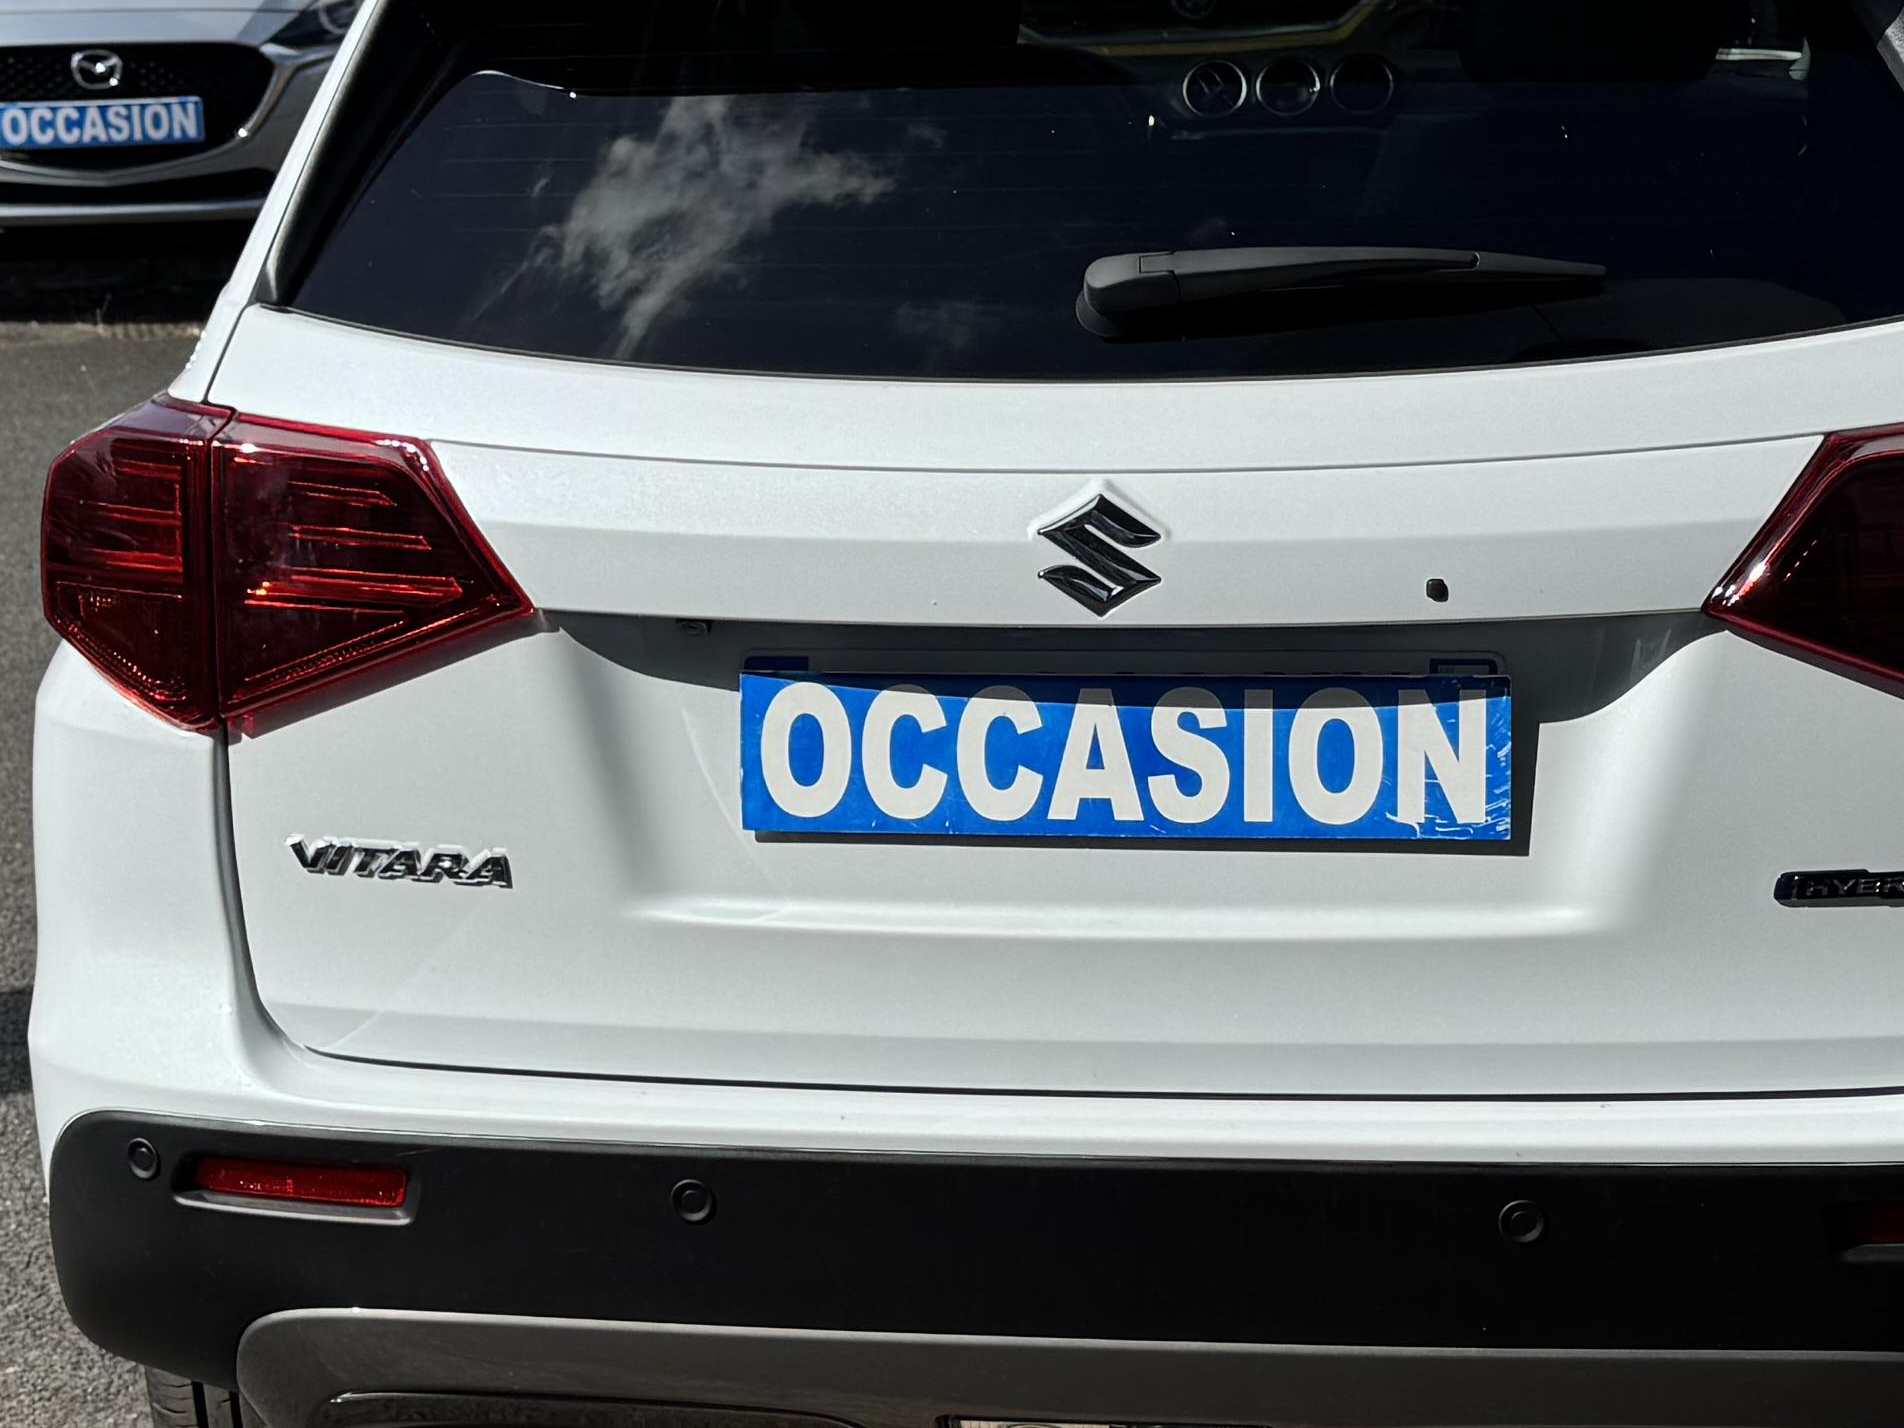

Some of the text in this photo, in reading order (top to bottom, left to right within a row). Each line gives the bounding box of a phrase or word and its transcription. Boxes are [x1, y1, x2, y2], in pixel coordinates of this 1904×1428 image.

[1, 102, 197, 145] OCCASION
[760, 681, 1487, 824] OCCASION
[285, 833, 514, 889] VITARA
